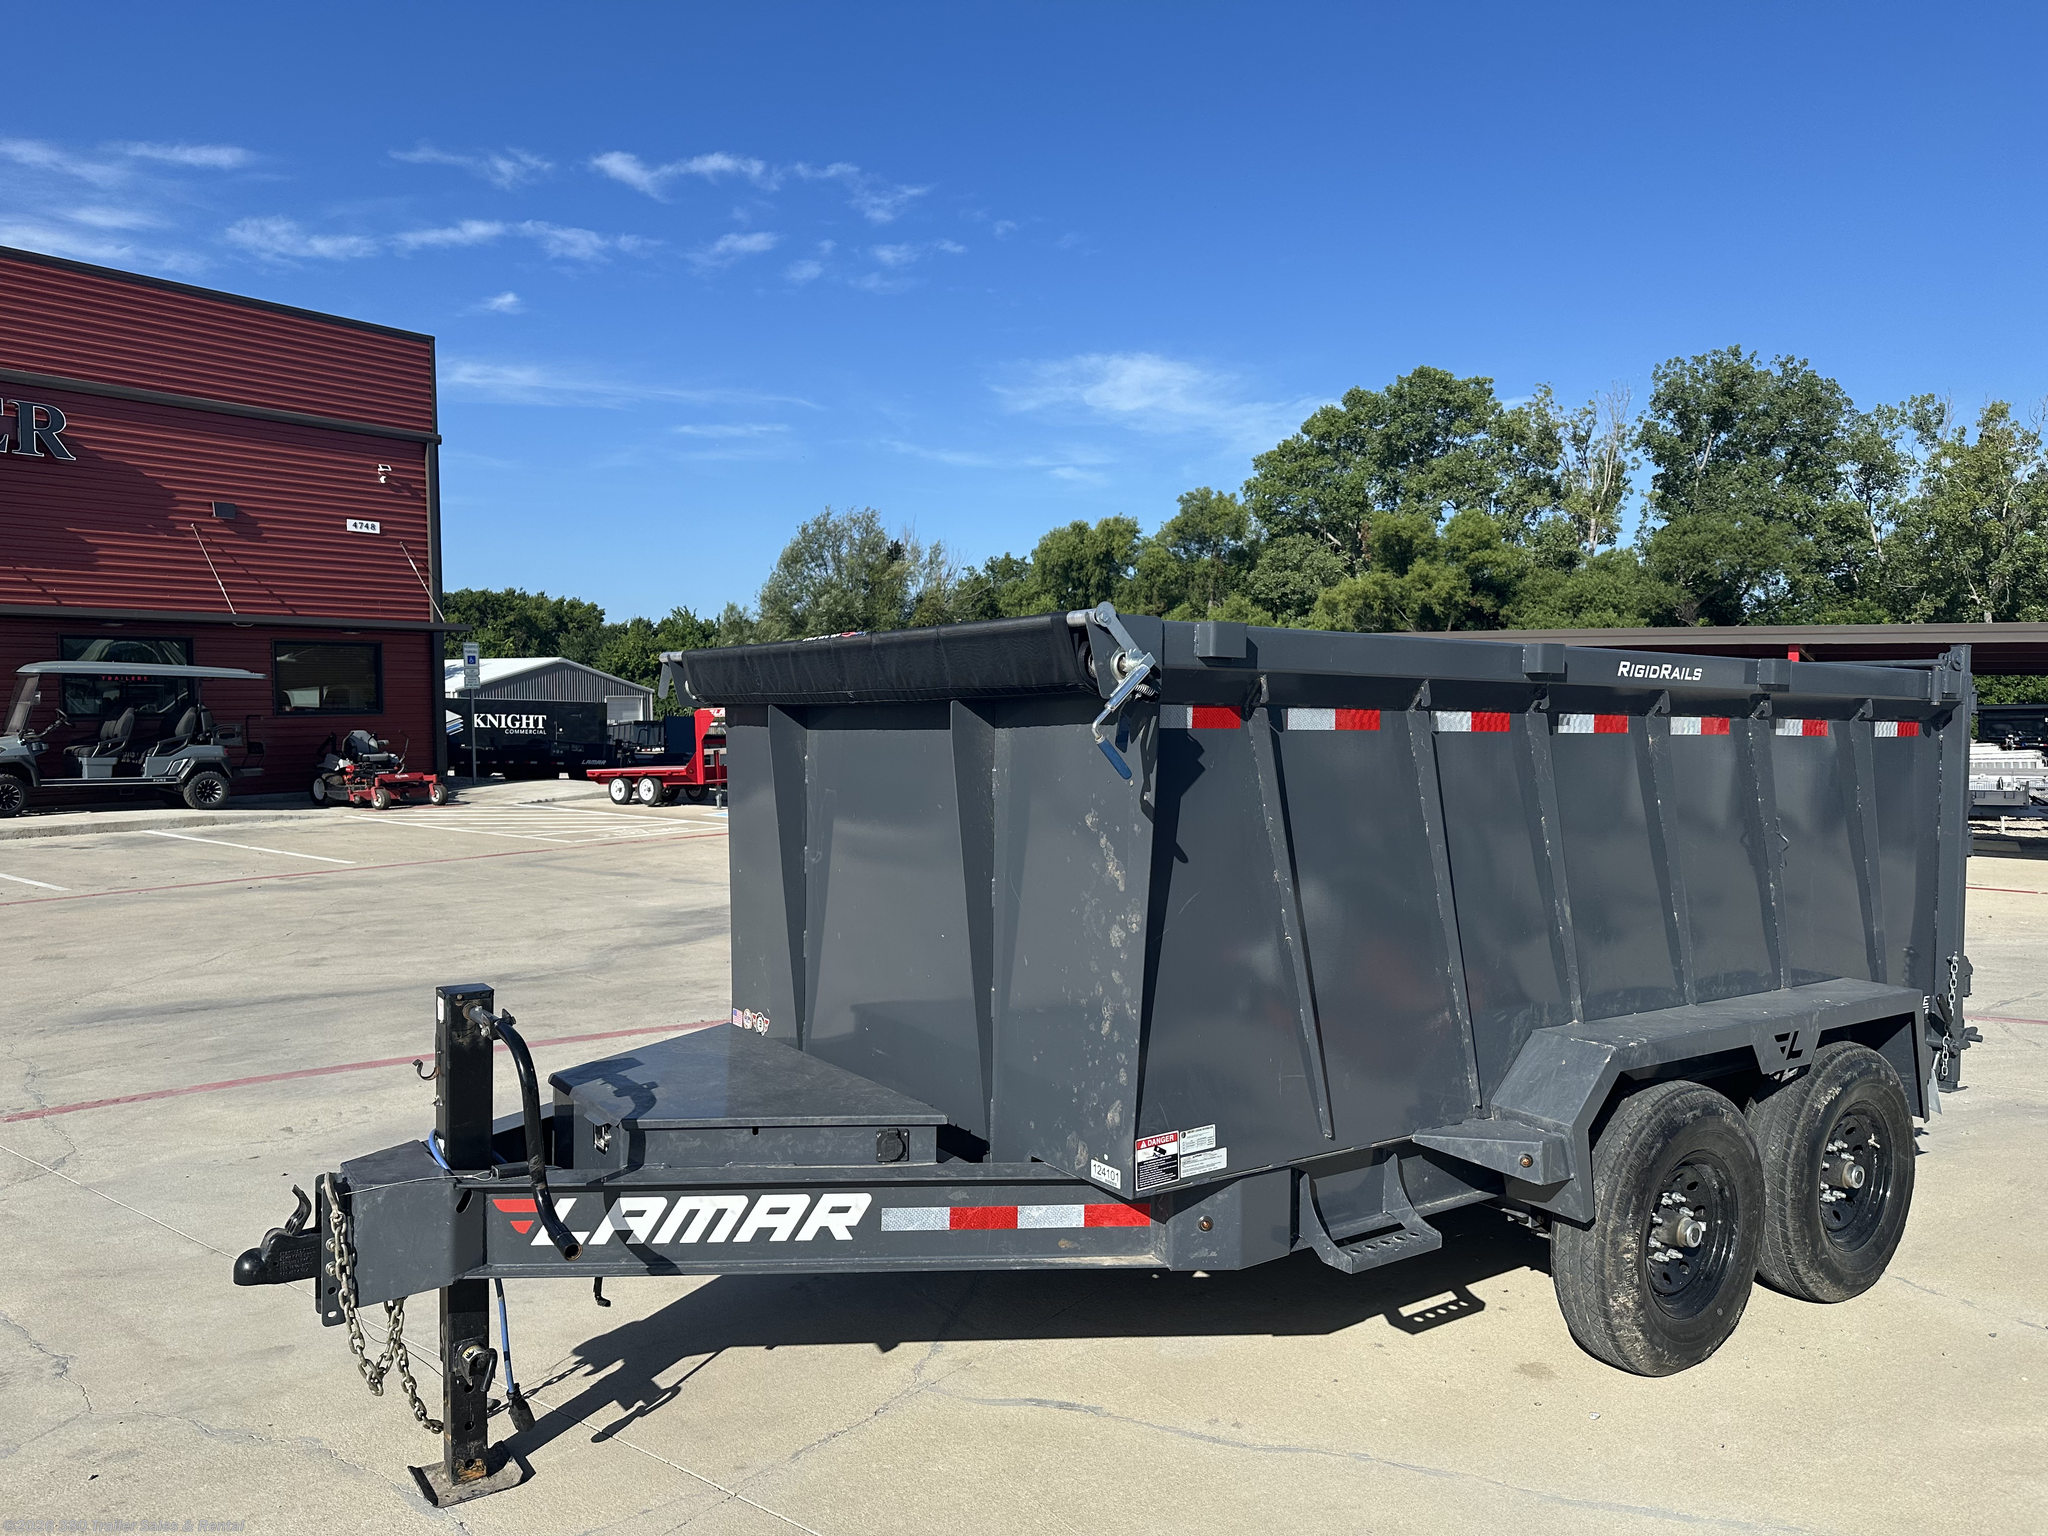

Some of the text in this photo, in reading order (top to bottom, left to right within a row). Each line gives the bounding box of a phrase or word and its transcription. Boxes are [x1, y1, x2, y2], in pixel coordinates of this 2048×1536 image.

[0, 398, 77, 461] R
[352, 521, 376, 531] 4748
[473, 713, 547, 729] KNIGHT
[1147, 1134, 1175, 1147] DANGER
[1093, 1163, 1119, 1183] 124101
[530, 1192, 873, 1246] LAMAR
